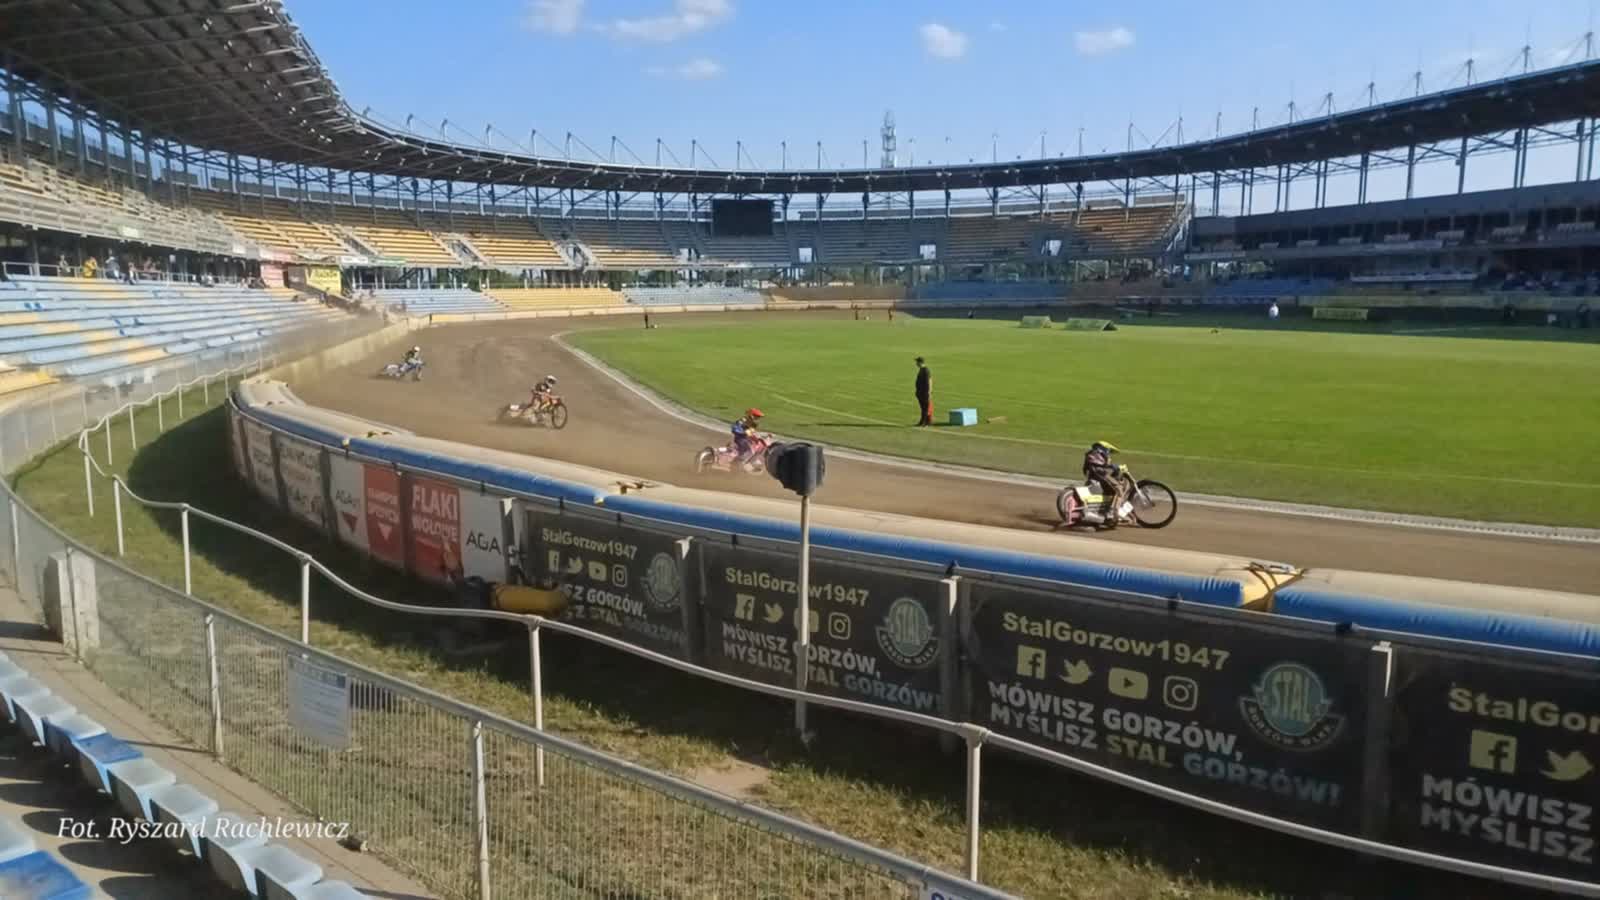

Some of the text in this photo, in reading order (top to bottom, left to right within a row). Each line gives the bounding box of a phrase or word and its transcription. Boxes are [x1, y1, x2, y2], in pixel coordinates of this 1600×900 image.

[412, 484, 458, 521] FLAKI
[542, 528, 638, 560] StalGorzow1947
[725, 567, 870, 607] StalGorzw1947
[1003, 611, 1231, 671] StalGorzow1947
[988, 679, 1244, 762] MÓWISZ GORZÓW,
[1271, 670, 1313, 723] STAL
[989, 701, 1342, 806] MYŚLISZ STAL GORZÓW!
[1422, 773, 1593, 831] MÓWISZ
[1420, 801, 1595, 865] MYŚLISZ
